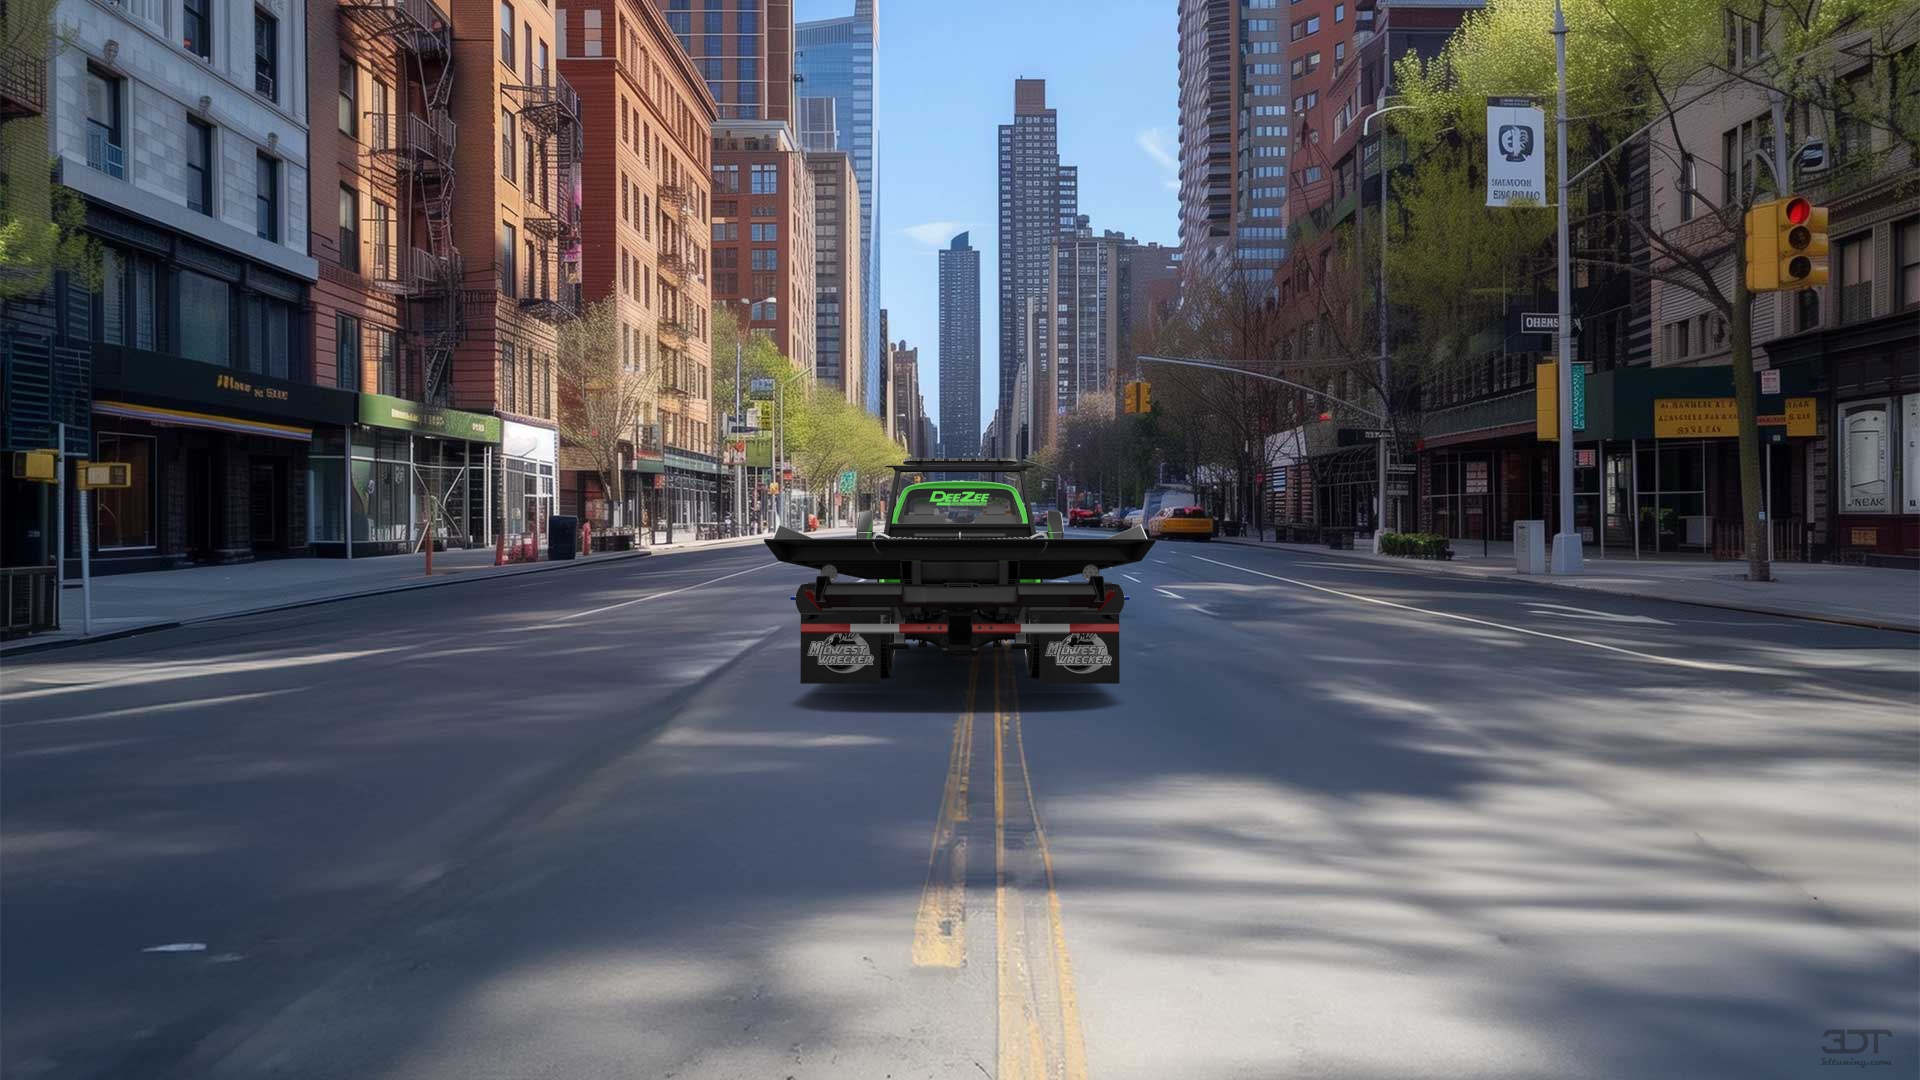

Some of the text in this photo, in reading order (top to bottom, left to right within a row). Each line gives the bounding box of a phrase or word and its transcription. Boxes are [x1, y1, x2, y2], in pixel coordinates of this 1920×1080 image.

[929, 491, 990, 502] DEEZEE
[807, 641, 867, 656] MIDWEST
[1045, 641, 1105, 656] MIDWEST
[818, 655, 874, 665] WRECKER
[1056, 655, 1112, 665] WRECKER
